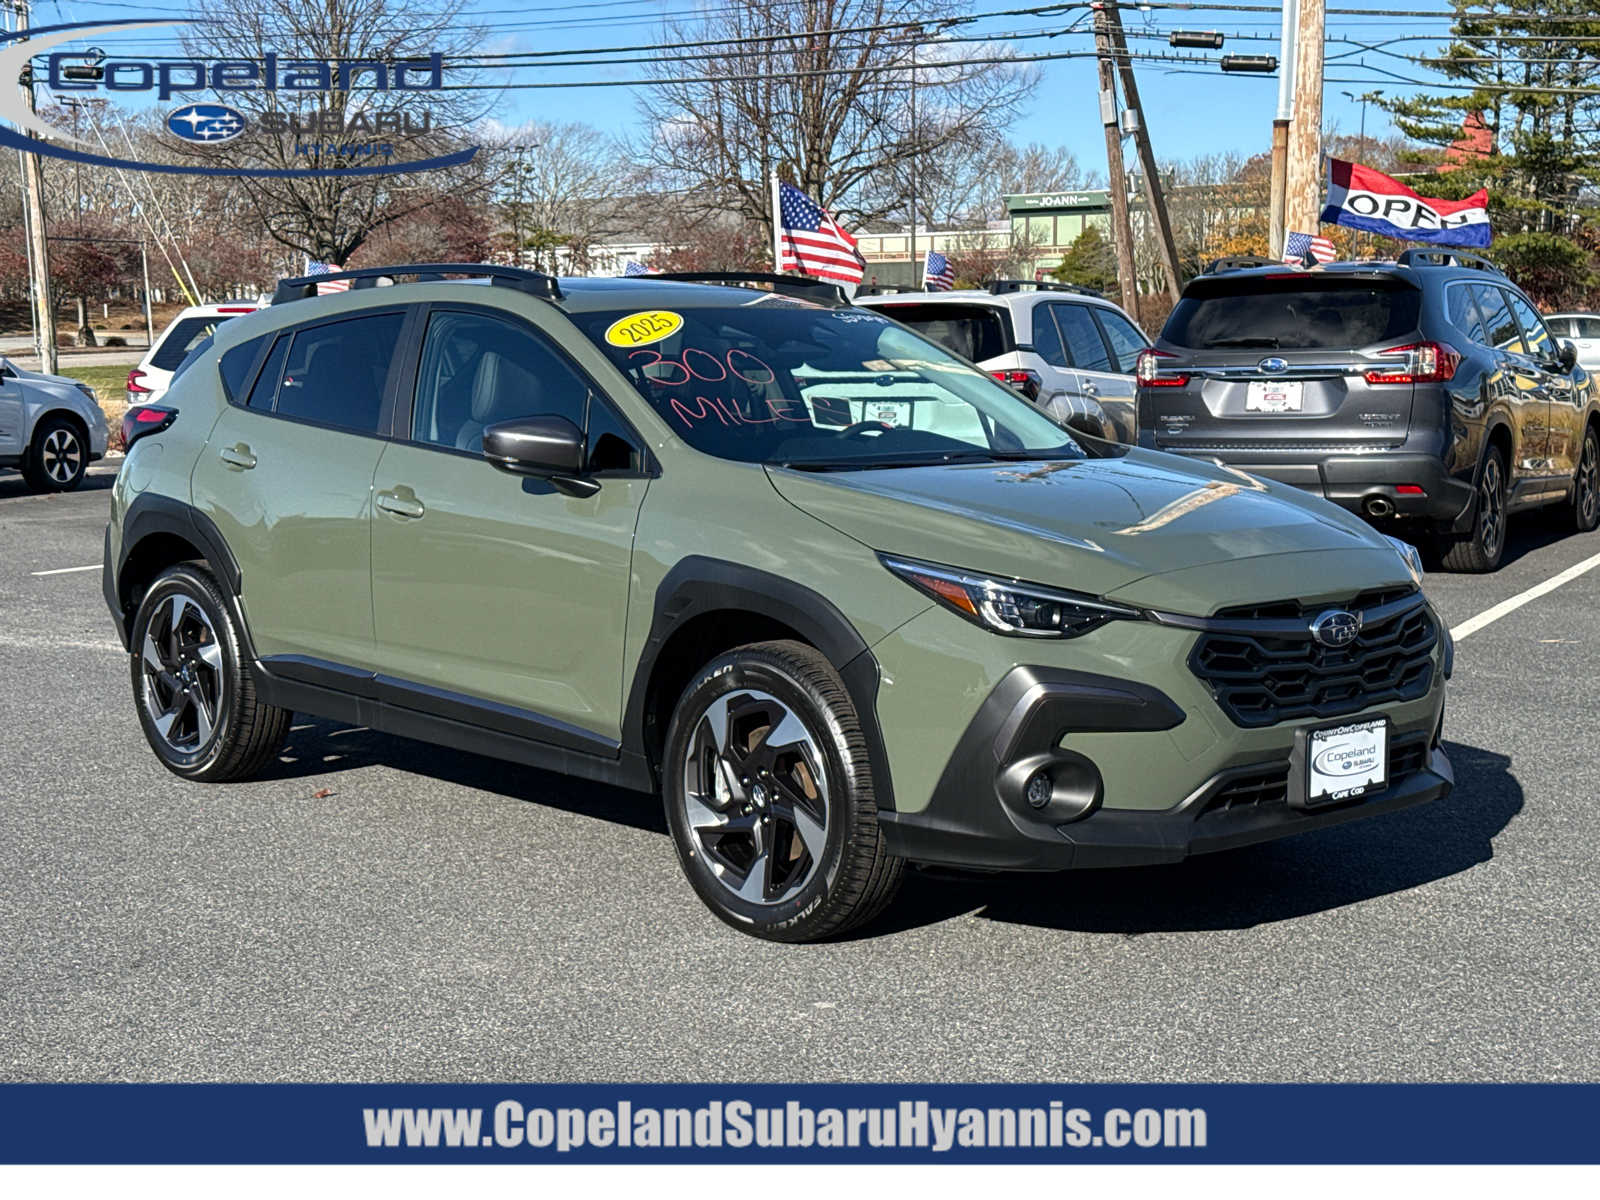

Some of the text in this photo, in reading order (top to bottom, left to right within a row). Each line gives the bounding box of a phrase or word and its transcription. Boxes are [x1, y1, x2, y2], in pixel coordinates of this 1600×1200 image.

[619, 314, 673, 343] 2025
[629, 348, 774, 385] 300
[1327, 744, 1376, 762] Copeland
